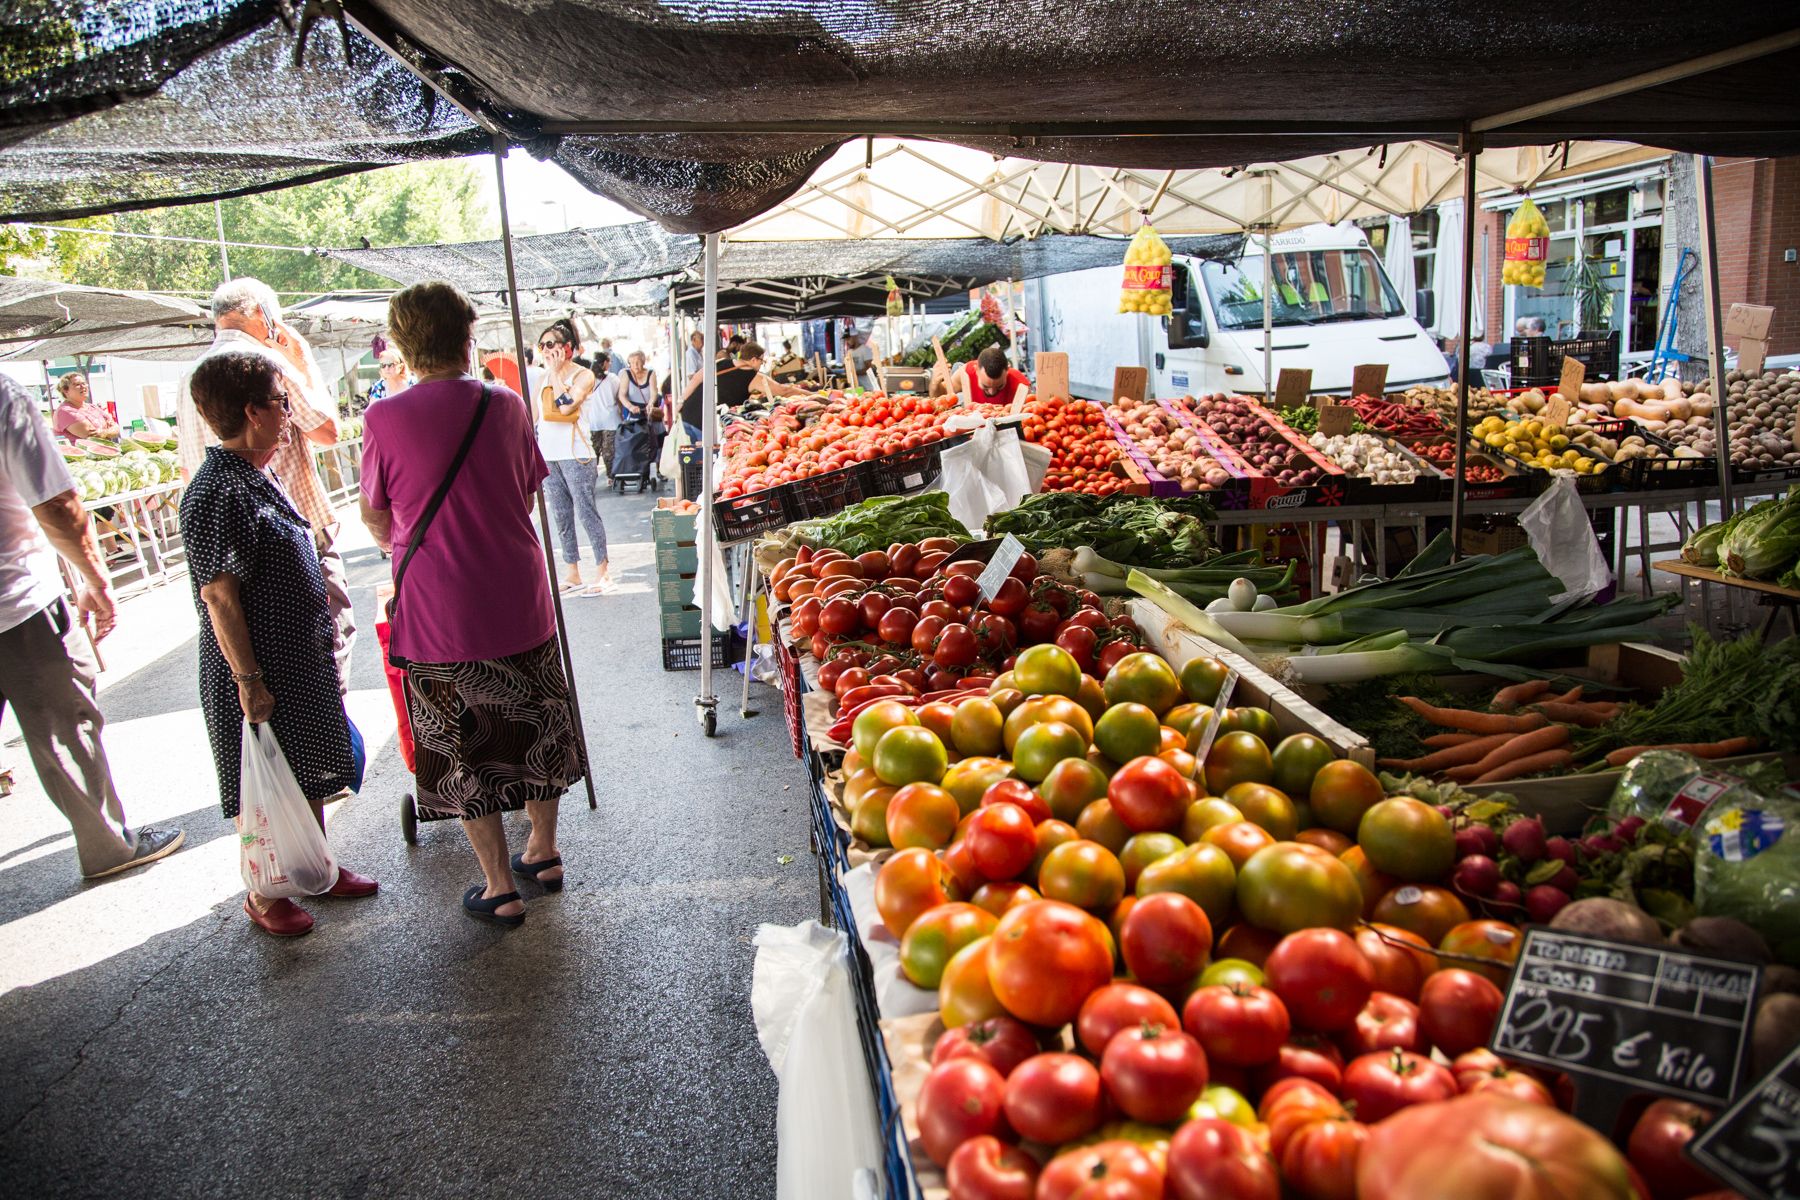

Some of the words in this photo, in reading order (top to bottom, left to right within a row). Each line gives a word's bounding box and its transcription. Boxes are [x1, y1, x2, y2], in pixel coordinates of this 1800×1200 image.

[1265, 489, 1308, 510] Cuqui
[1528, 966, 1597, 993] ROSA
[1612, 1031, 1654, 1069] €
[1656, 1042, 1717, 1089] Kilo
